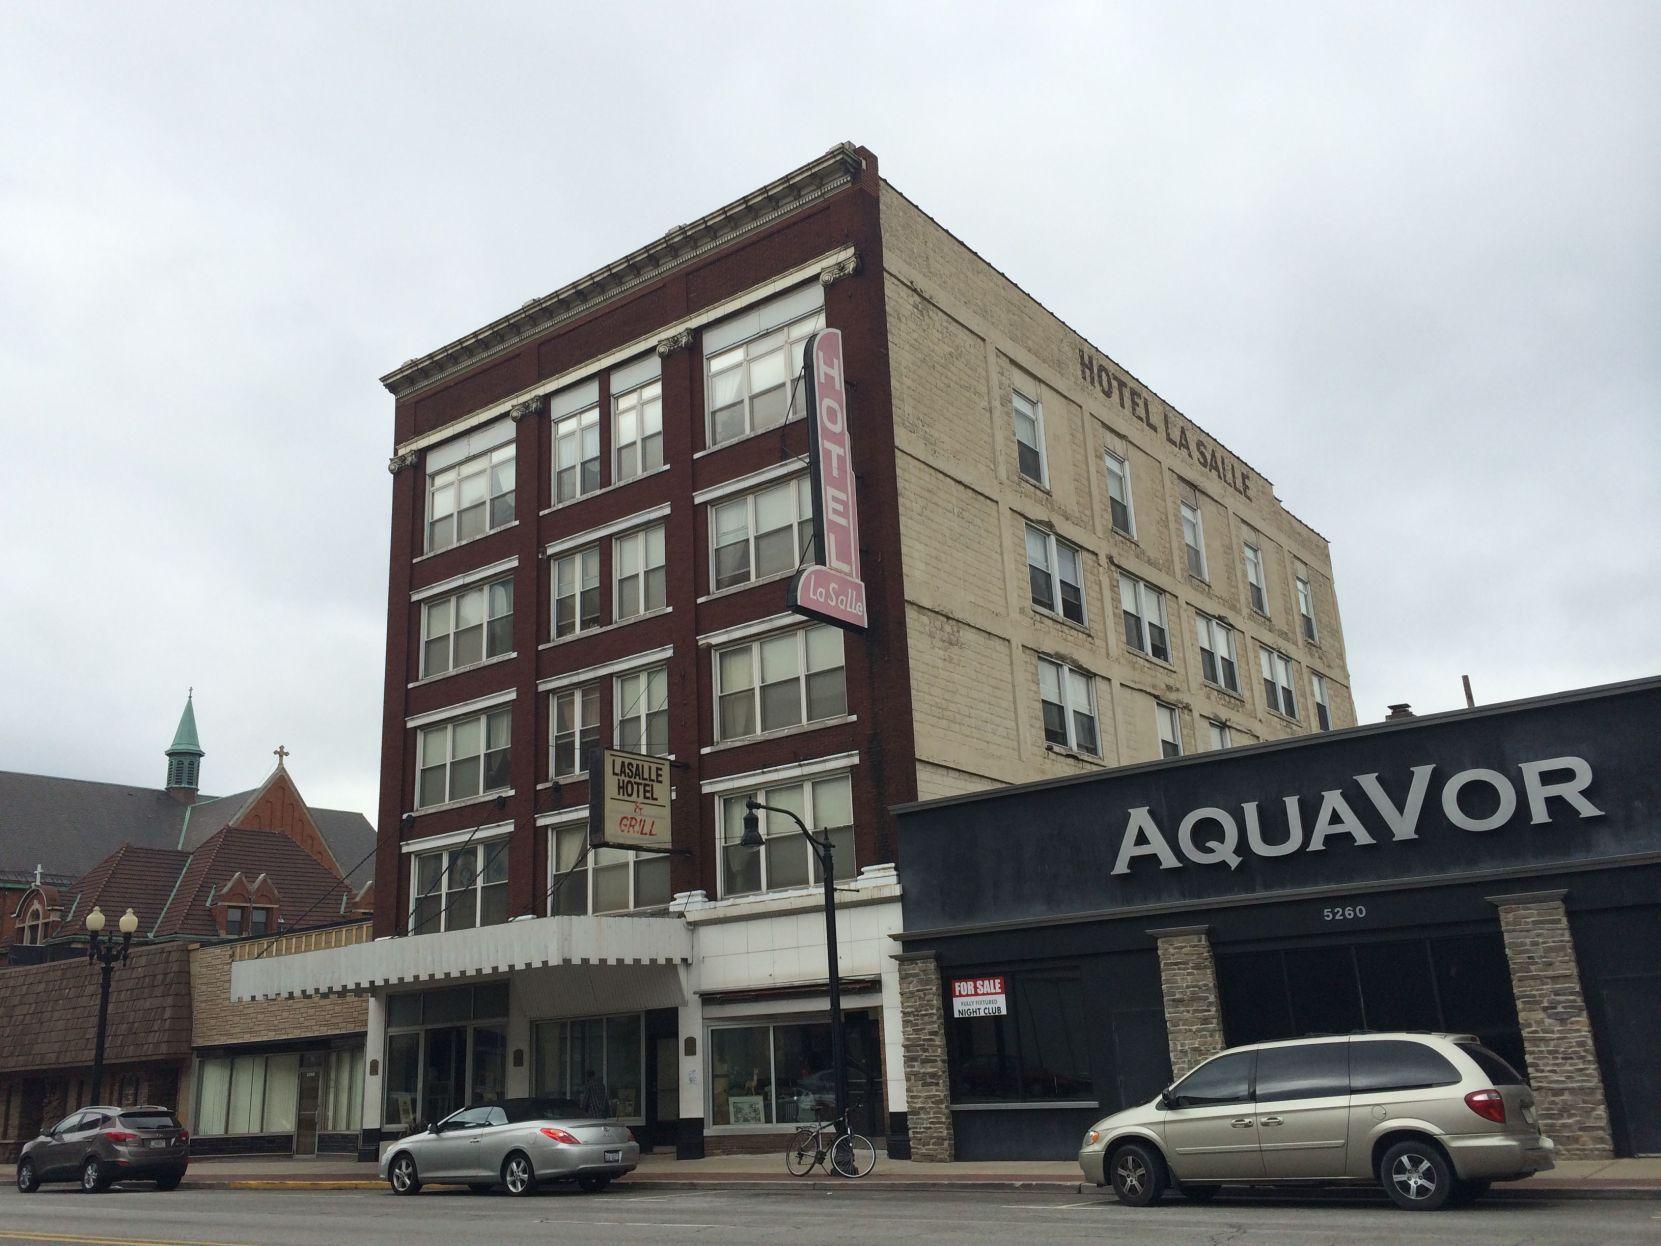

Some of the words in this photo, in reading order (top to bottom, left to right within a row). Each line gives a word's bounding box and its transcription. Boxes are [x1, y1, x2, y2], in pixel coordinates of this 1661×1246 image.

[1078, 347, 1158, 433] HOTEL
[1195, 439, 1253, 502] SALLE
[818, 350, 851, 572] HOTEL
[612, 758, 663, 784] LASALLE
[617, 778, 659, 801] HOTEL
[619, 816, 657, 837] GRILL
[1109, 755, 1606, 875] AQUAVOR
[1323, 905, 1367, 921] 5260
[955, 981, 975, 996] FOR
[976, 979, 1002, 994] SALE
[958, 1007, 981, 1017] NIGHT
[983, 1006, 1002, 1015] CLUB
